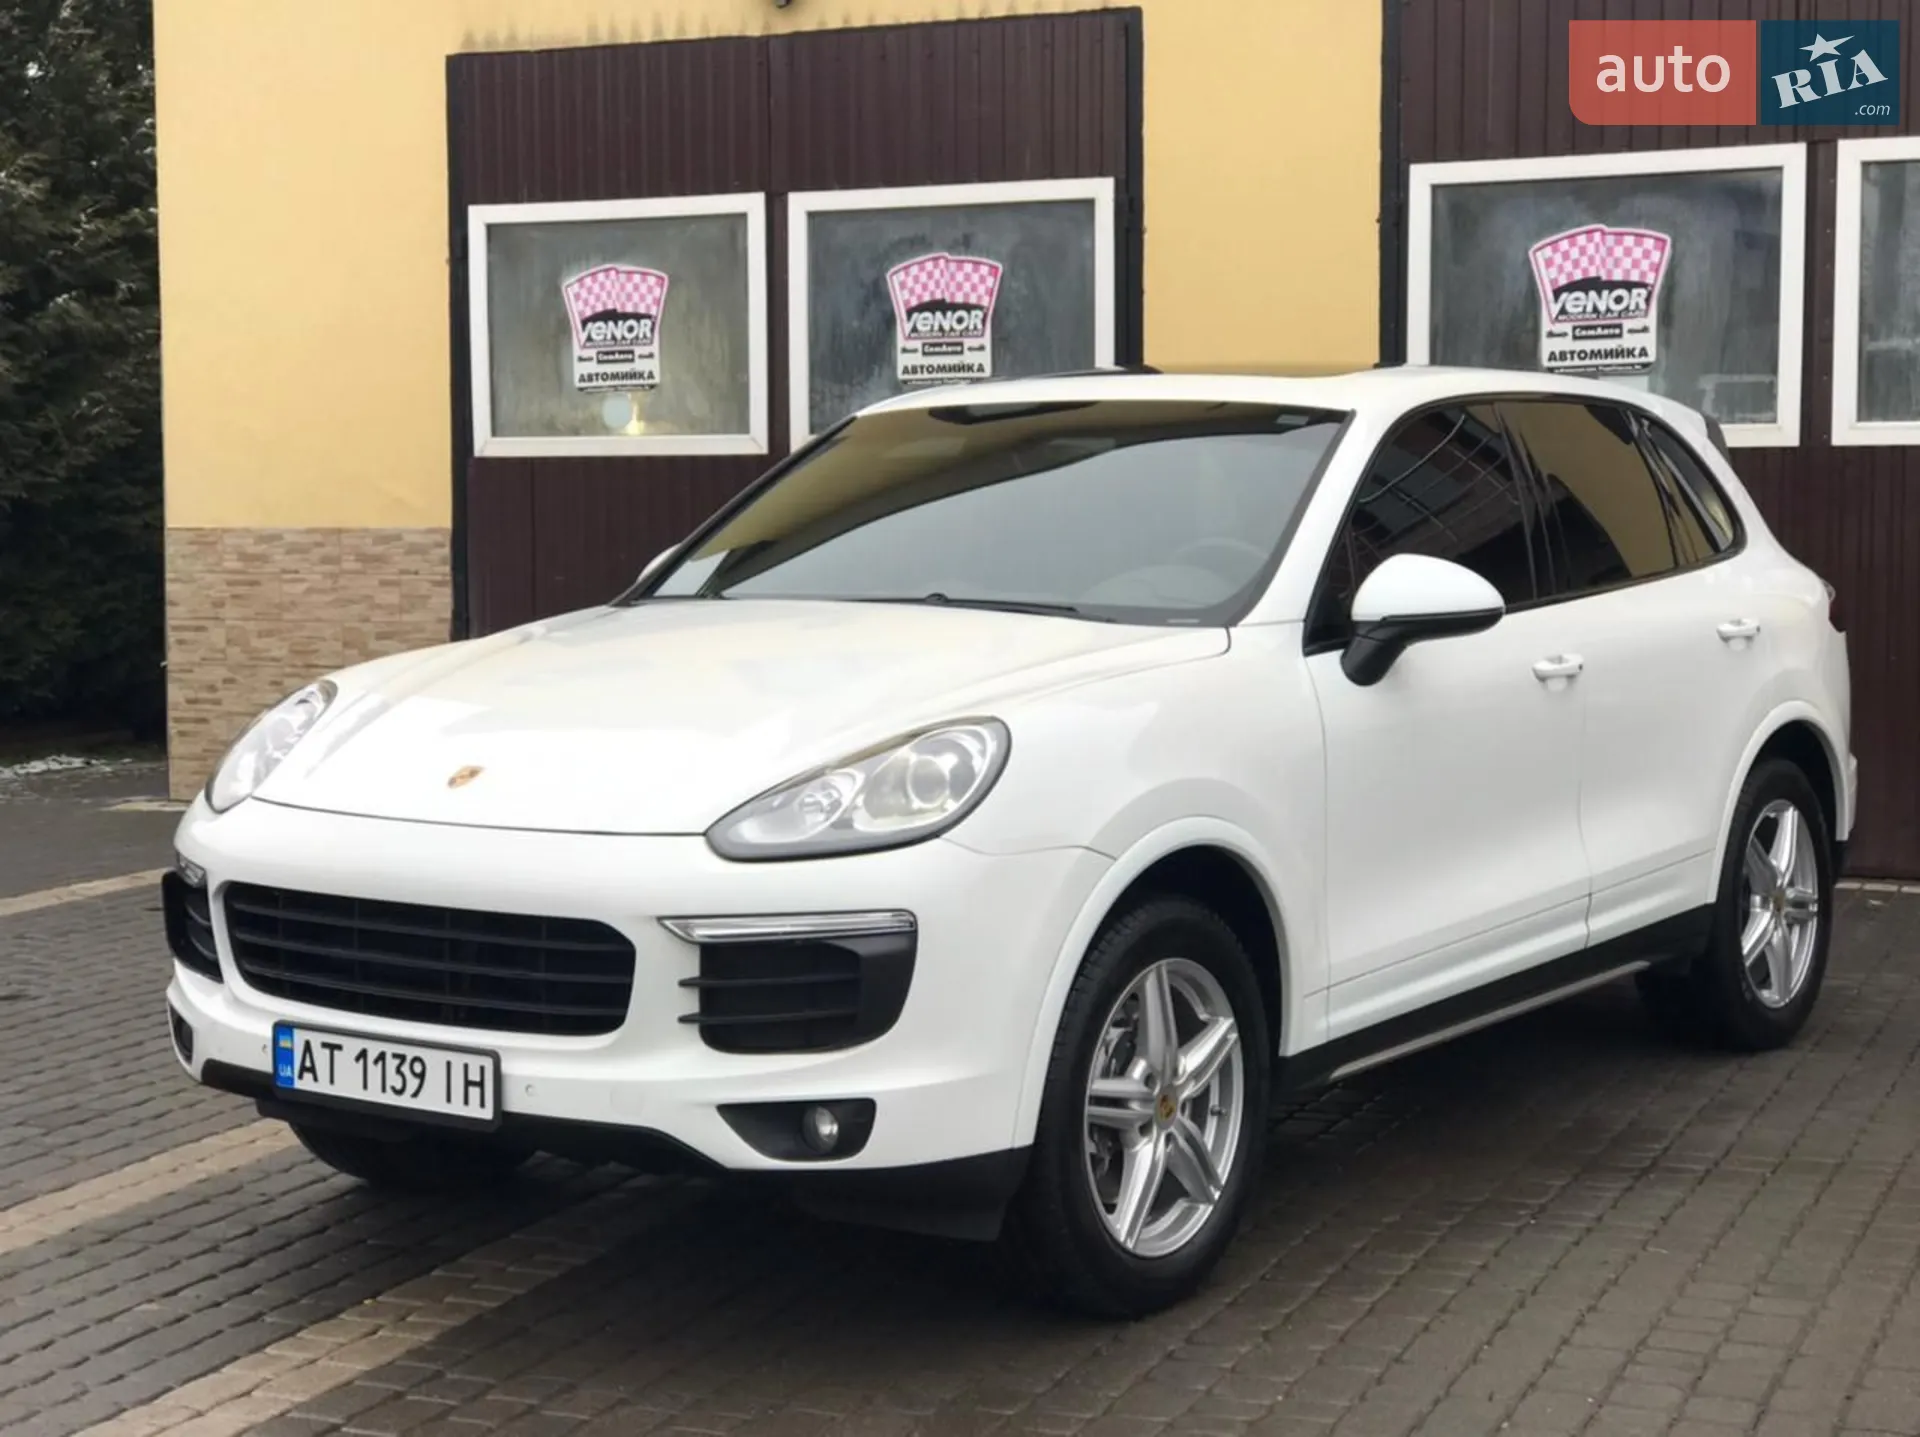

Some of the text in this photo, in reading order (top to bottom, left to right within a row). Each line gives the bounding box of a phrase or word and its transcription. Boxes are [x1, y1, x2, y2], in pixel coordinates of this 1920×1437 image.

[1547, 345, 1649, 363] АВТОМИЙКА
[578, 369, 656, 384] АВТОМИЙКА
[901, 361, 985, 376] АВТОМИЙКА
[297, 1038, 486, 1109] AT 1139 IH
